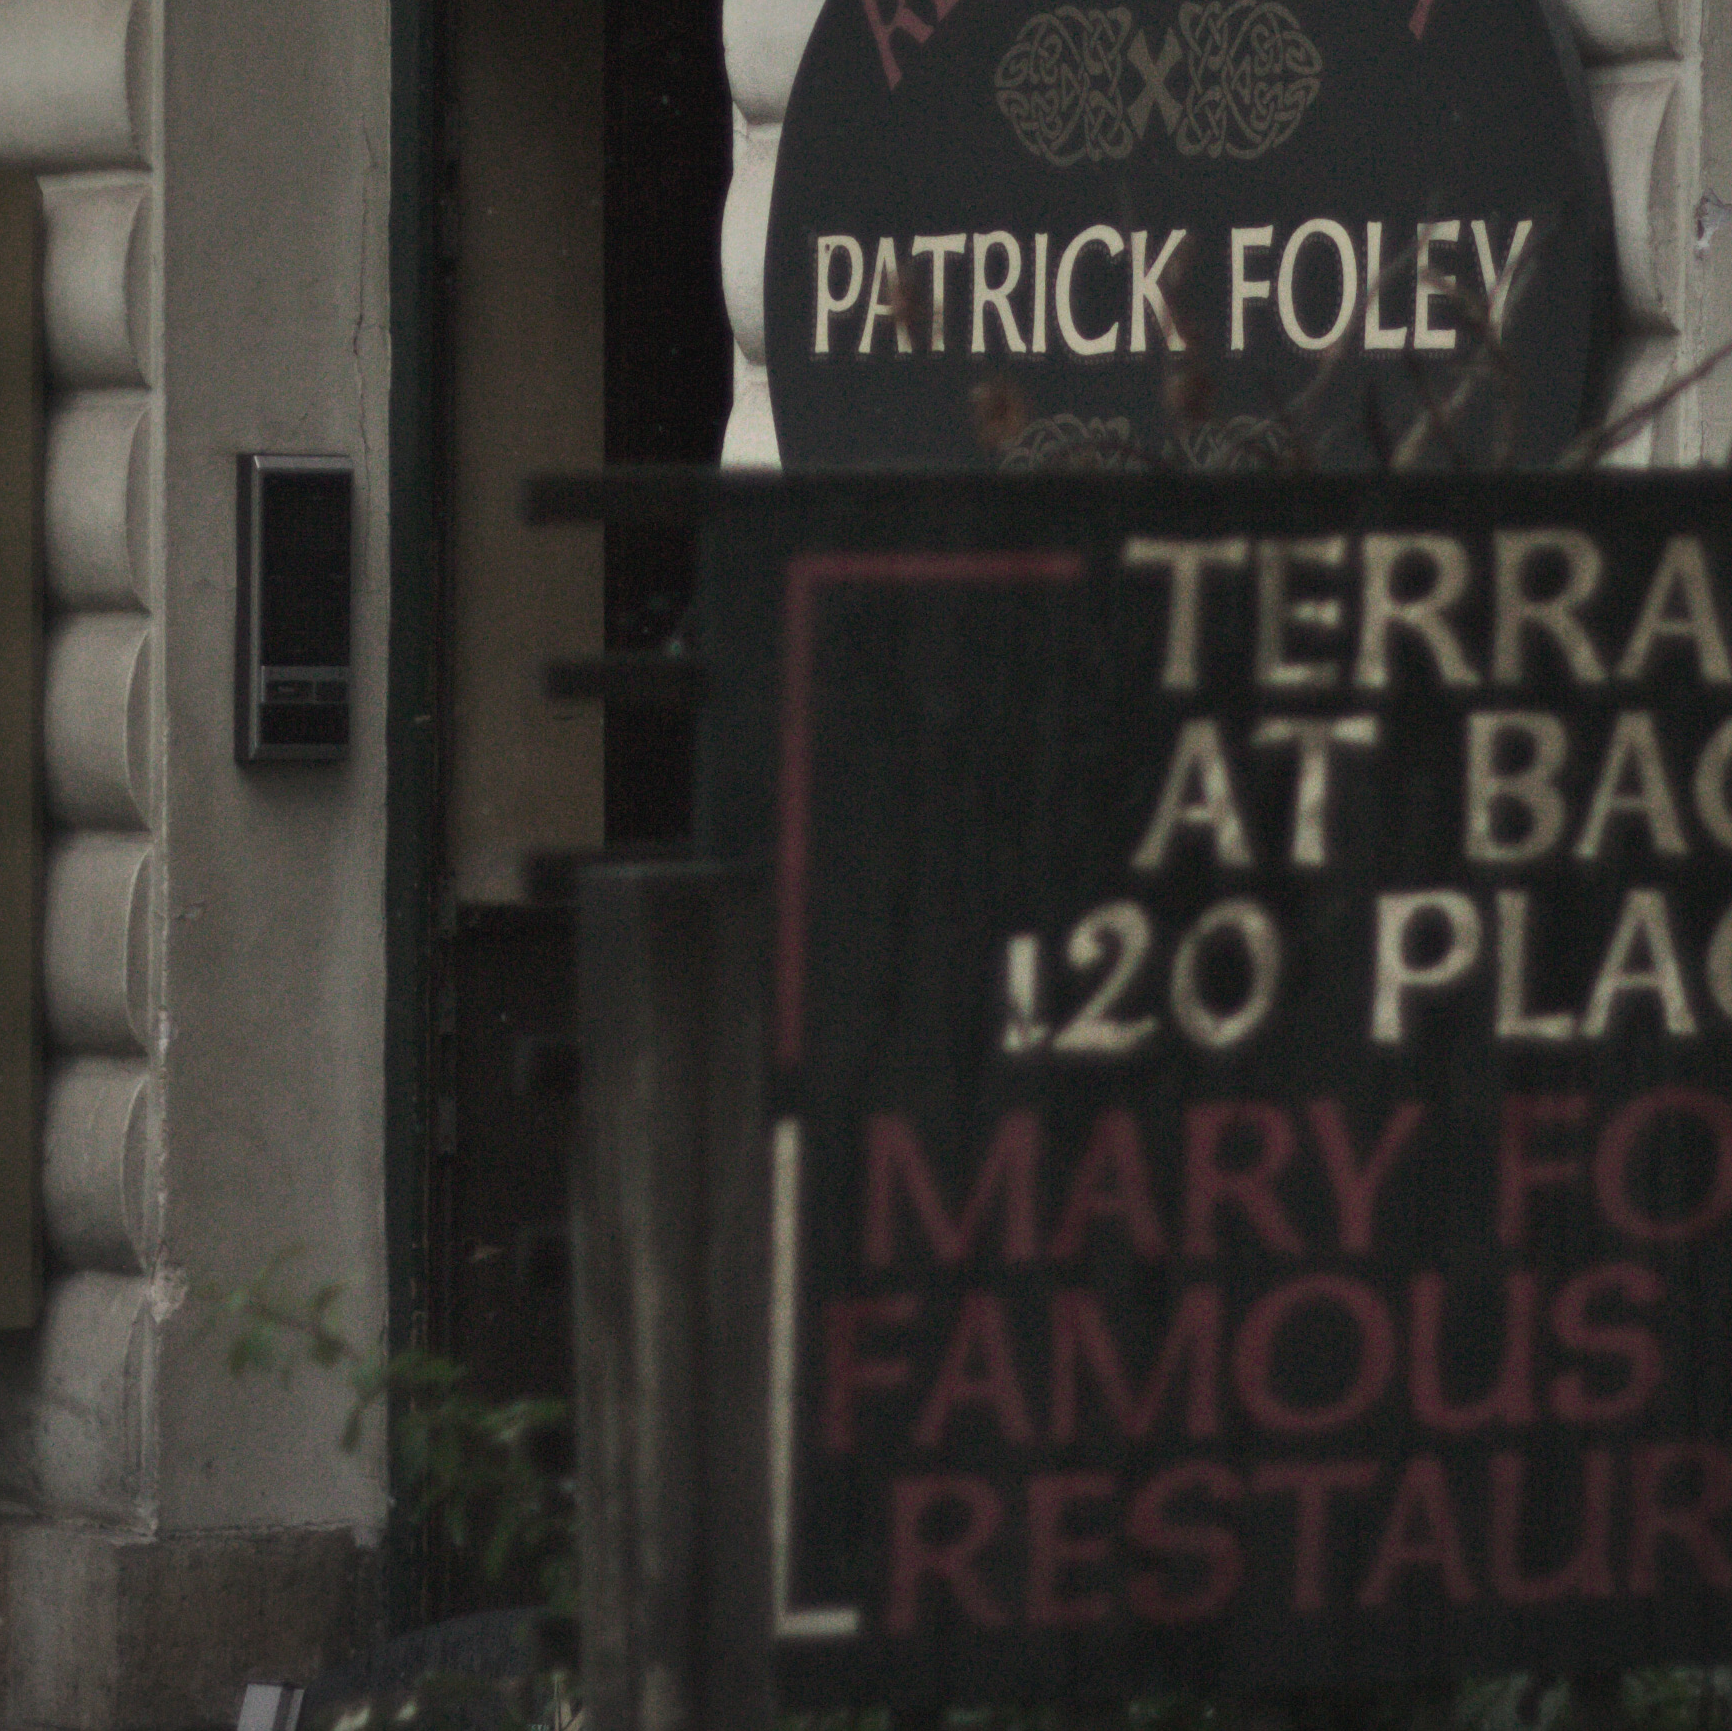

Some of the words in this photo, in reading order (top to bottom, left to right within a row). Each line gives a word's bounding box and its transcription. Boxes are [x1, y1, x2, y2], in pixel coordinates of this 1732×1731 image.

[813, 223, 1188, 356] PATRICK
[1229, 217, 1533, 352] FOLEY
[1129, 714, 1380, 871] AT
[862, 1093, 1424, 1266] MARY
[817, 1266, 1666, 1453] FAMOUS
